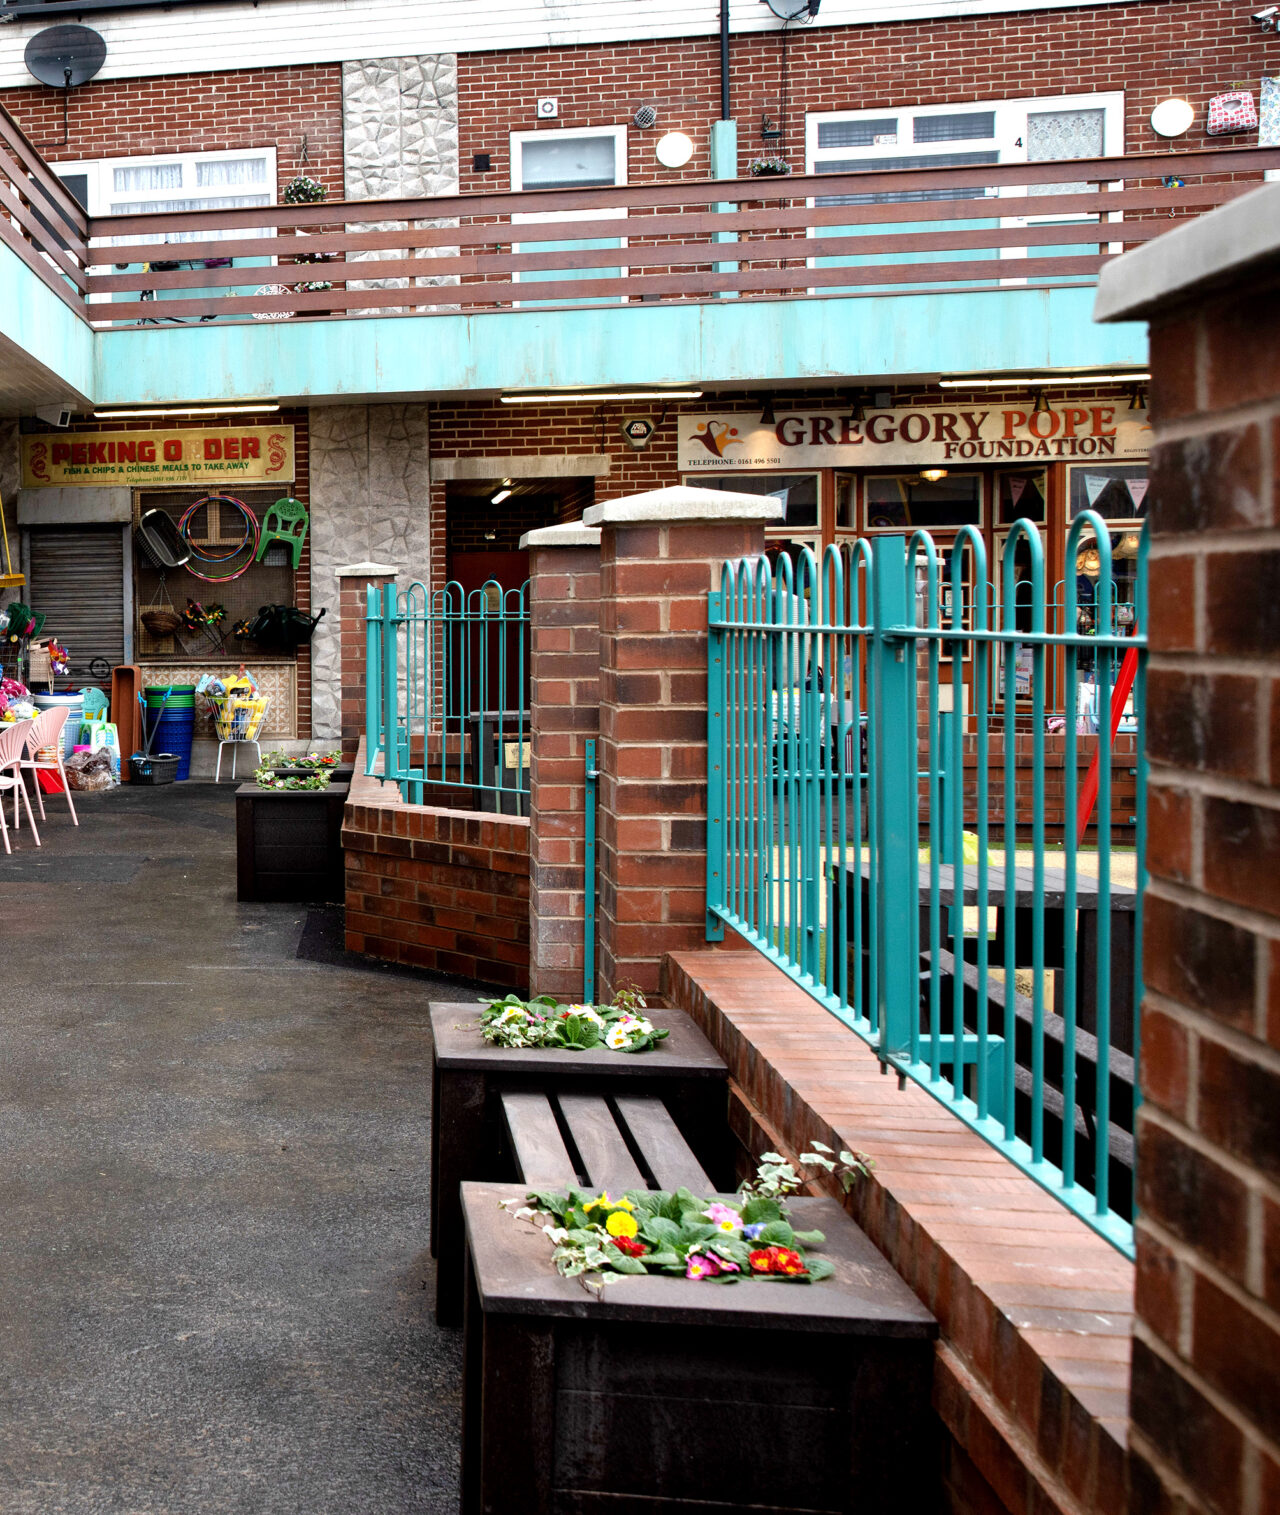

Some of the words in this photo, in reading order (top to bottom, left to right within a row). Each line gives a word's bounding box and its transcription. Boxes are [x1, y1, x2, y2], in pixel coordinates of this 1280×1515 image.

[1014, 136, 1023, 148] 4
[775, 411, 990, 447] GREGORY
[1001, 406, 1118, 440] POPE
[51, 440, 157, 465] PEKING
[163, 437, 261, 462] ODER
[943, 437, 1117, 459] FOUNDATION
[63, 467, 82, 475] FISH
[92, 466, 116, 474] CHIPS
[118, 465, 124, 473] &
[126, 464, 160, 473] CHINESE
[162, 463, 189, 472] MEALS
[191, 463, 202, 471] TO
[204, 462, 225, 470] TAKE
[226, 461, 250, 470] AWAY
[687, 458, 737, 466] TELEPHONE:
